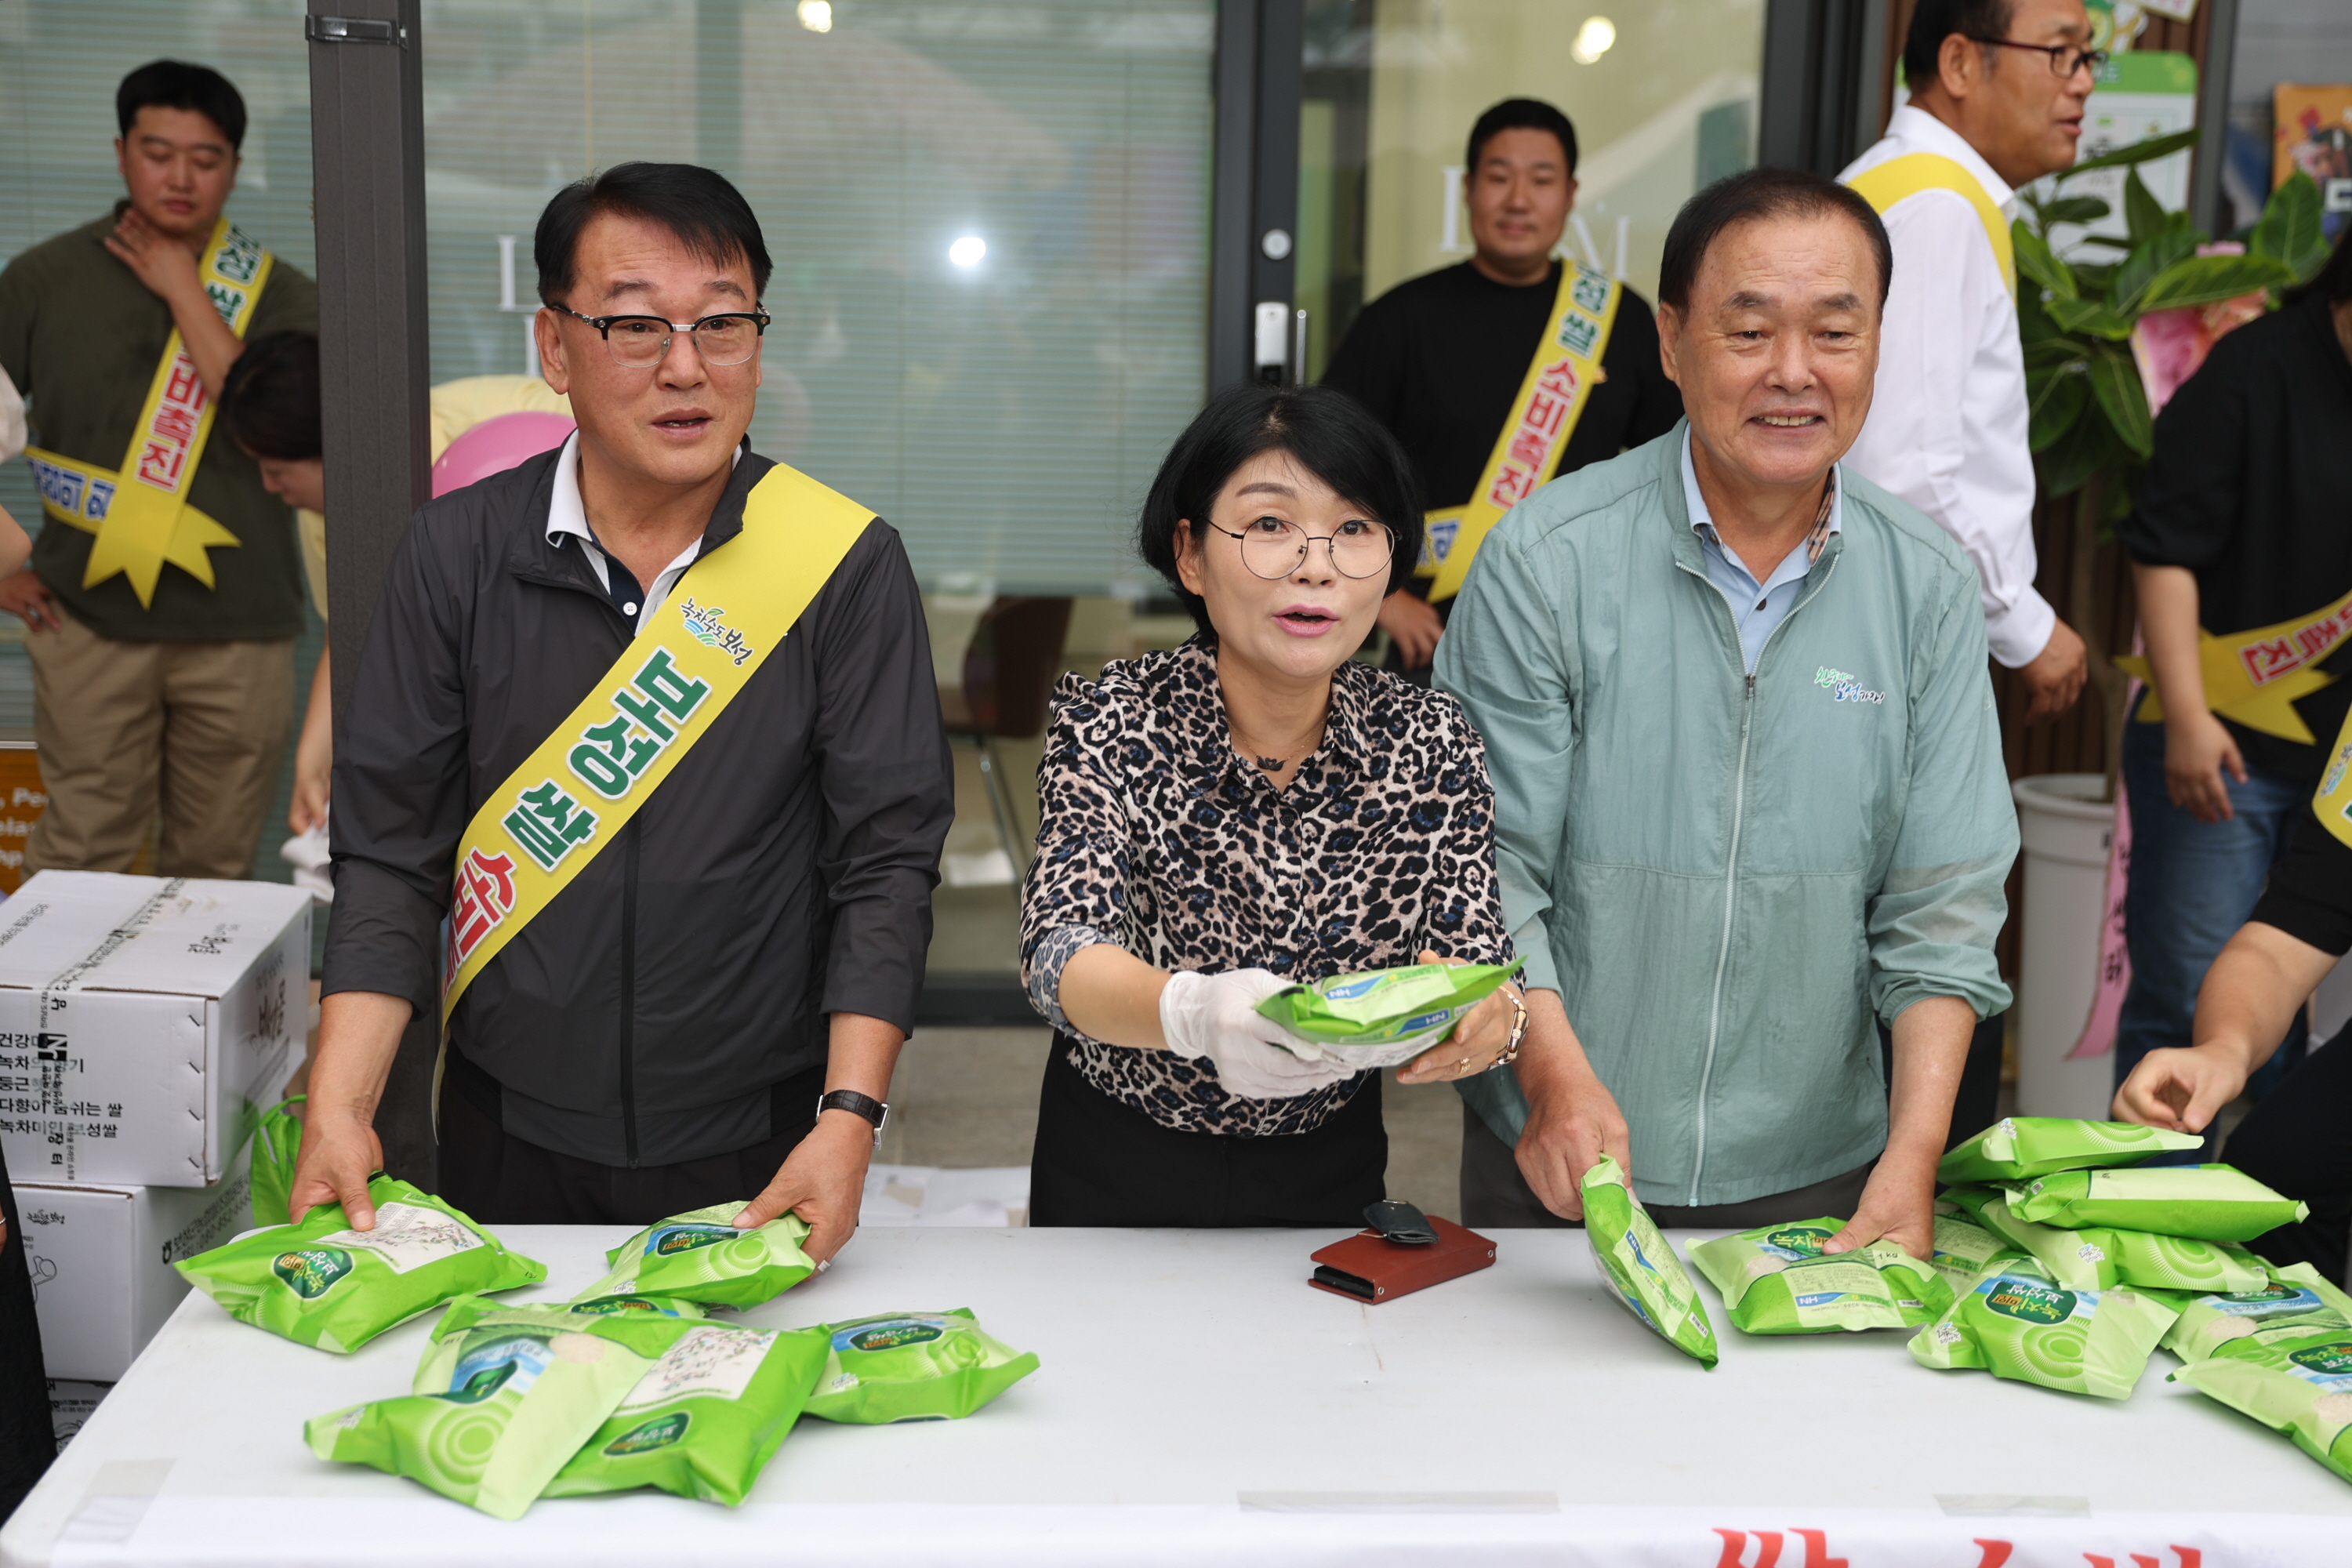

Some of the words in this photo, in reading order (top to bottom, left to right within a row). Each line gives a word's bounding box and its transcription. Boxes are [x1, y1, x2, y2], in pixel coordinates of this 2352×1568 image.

[1560, 314, 1597, 358] 쌀
[139, 354, 207, 488] 비촉진
[1490, 361, 1575, 508] 소비촉진
[681, 597, 726, 639] 녹차수도
[719, 629, 753, 666] 보성
[568, 648, 710, 797] 보성
[502, 780, 599, 870] 쌀
[444, 848, 516, 996] 소비
[1328, 988, 1351, 999] NH
[1425, 1011, 1448, 1025] NH
[107, 1102, 123, 1118] 쌀
[72, 1123, 118, 1138] 보성쌀
[1628, 1233, 1639, 1252] NH
[1773, 1229, 1828, 1250] 녹차미
[1886, 1251, 1899, 1261] kg
[278, 1253, 326, 1293] 녹차미인
[1799, 1294, 1819, 1305] NH
[2005, 1284, 2064, 1304] 보성쌀
[1991, 1293, 2063, 1321] 녹차미인
